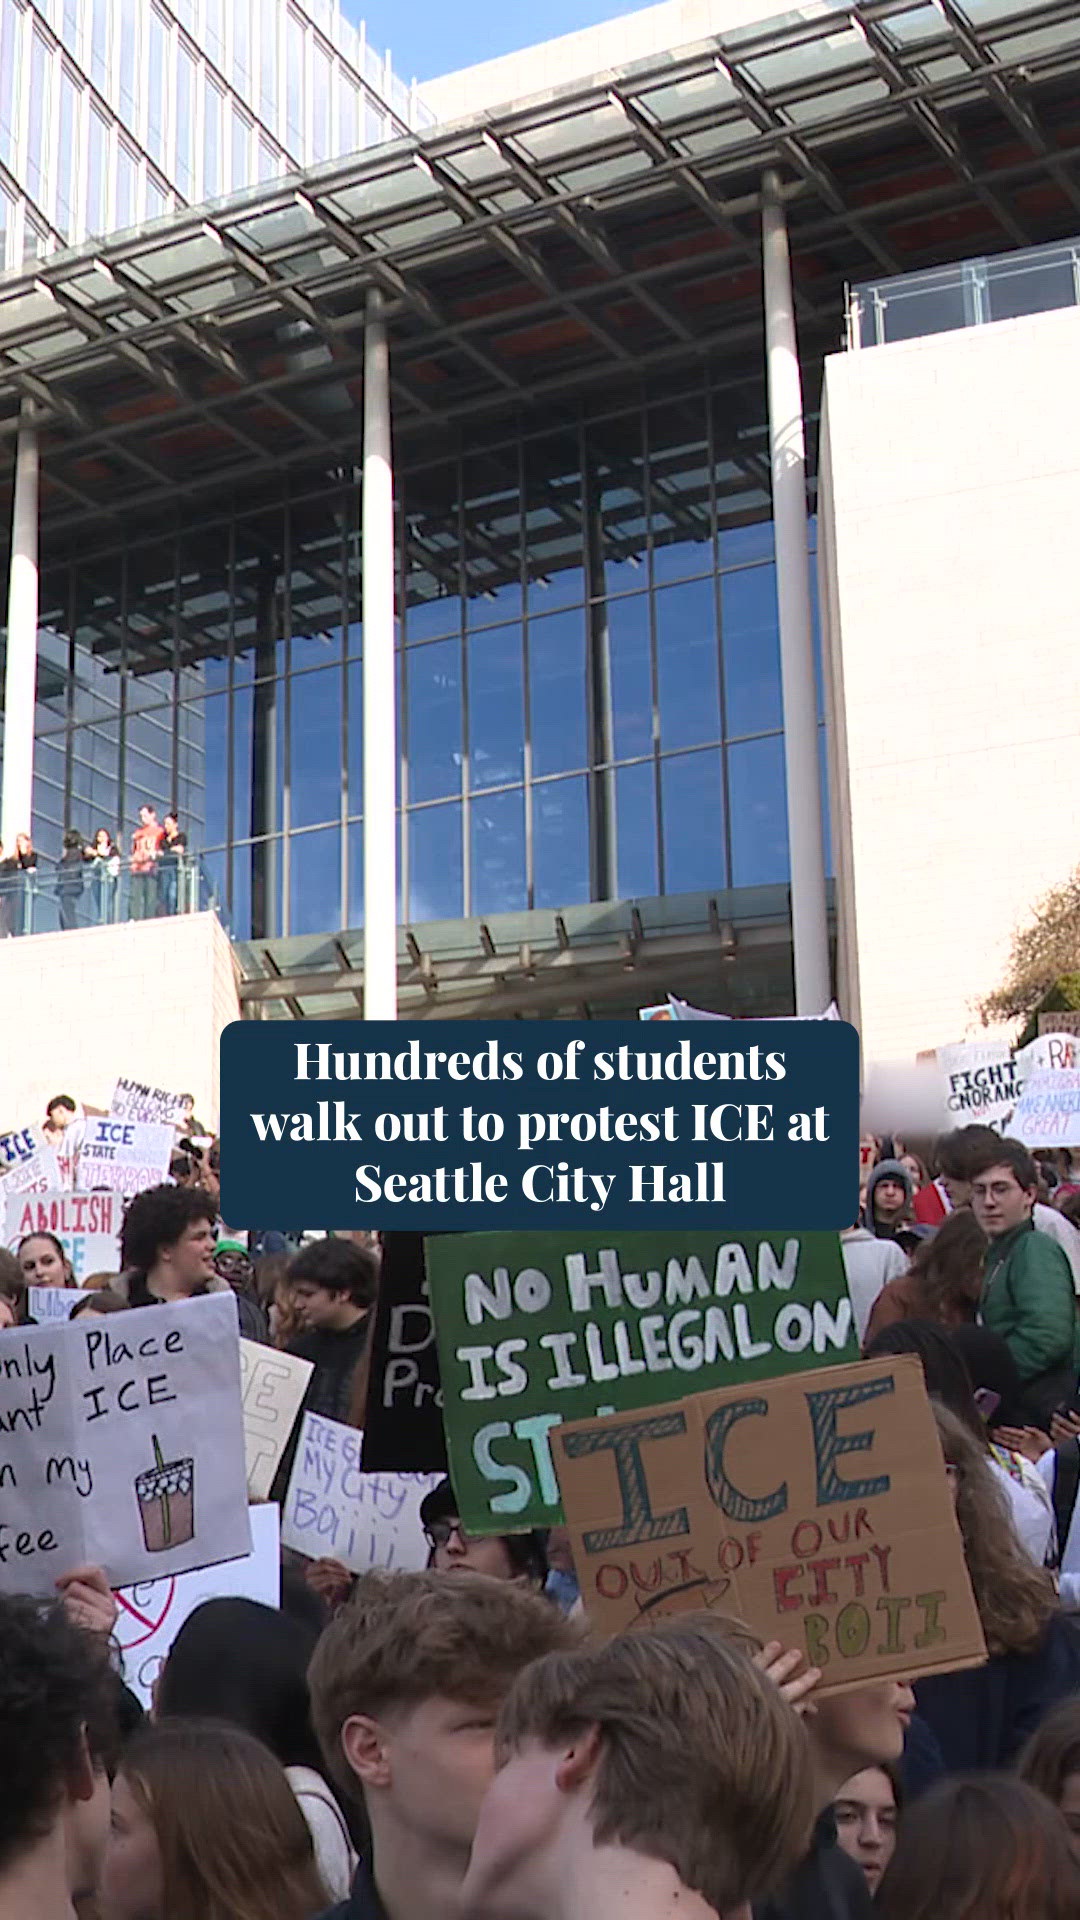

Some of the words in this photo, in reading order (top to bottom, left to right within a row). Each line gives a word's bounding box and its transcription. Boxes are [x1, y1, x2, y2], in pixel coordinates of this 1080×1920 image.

[946, 1080, 1024, 1111] GNORANC
[950, 1061, 1017, 1091] FIGHT
[0, 1128, 36, 1161] ICE
[82, 1143, 116, 1160] STATE
[95, 1121, 136, 1145] ICE
[20, 1196, 112, 1234] ABOLISH
[464, 1267, 553, 1325] NO
[564, 1238, 800, 1312] HUMAN
[0, 1344, 56, 1402] nly
[86, 1331, 184, 1371] Place
[456, 1338, 528, 1400] IS
[539, 1303, 773, 1390] ILLEGAL
[774, 1297, 852, 1354] ON
[83, 1374, 177, 1422] ICE
[306, 1417, 337, 1450] ICE
[303, 1447, 336, 1494] My
[562, 1375, 895, 1553] ICE
[717, 1530, 763, 1574] OF
[791, 1506, 875, 1558] OUR
[772, 1543, 892, 1615] CITY
